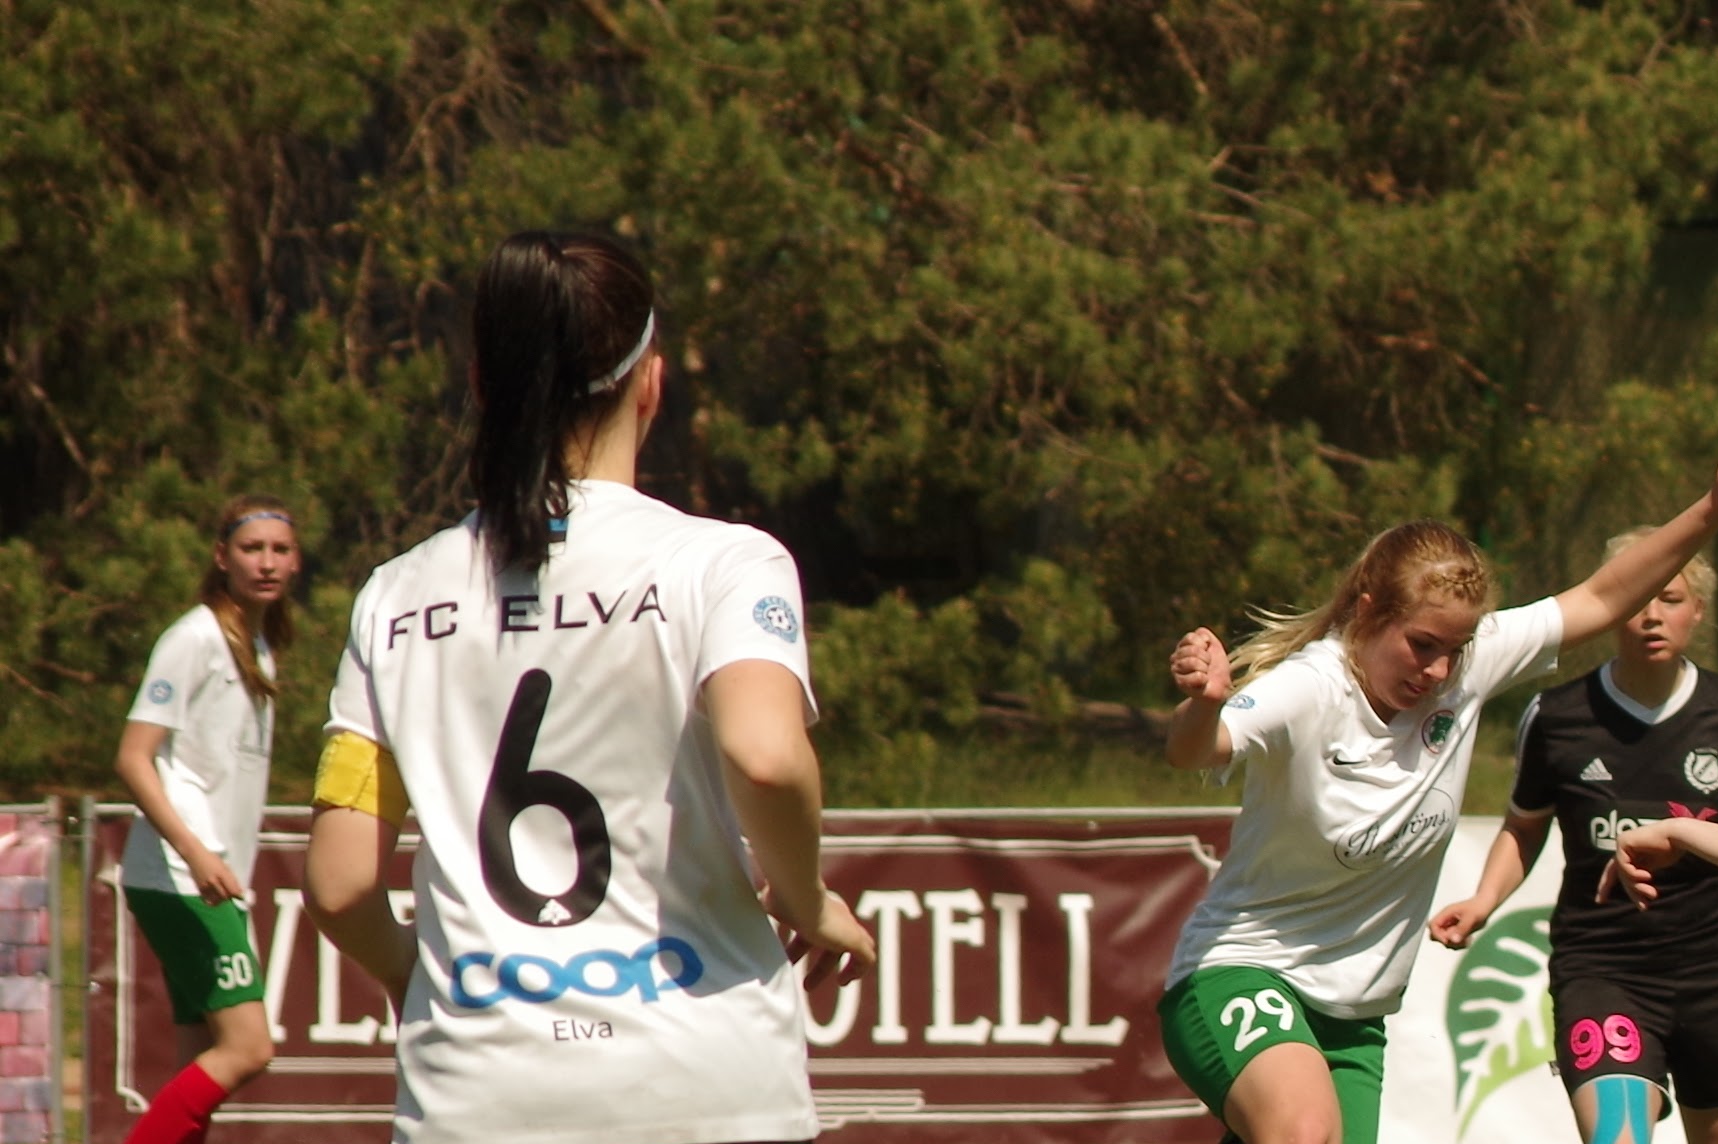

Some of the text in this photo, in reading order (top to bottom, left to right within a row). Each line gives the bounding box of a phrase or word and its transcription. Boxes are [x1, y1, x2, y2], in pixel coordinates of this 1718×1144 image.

[387, 583, 668, 650] FC ELVA
[478, 668, 612, 928] 6
[213, 951, 254, 990] 50
[450, 936, 704, 1009] coop
[553, 1019, 615, 1042] Elva
[1220, 988, 1294, 1052] 29
[1570, 1014, 1641, 1070] 99
